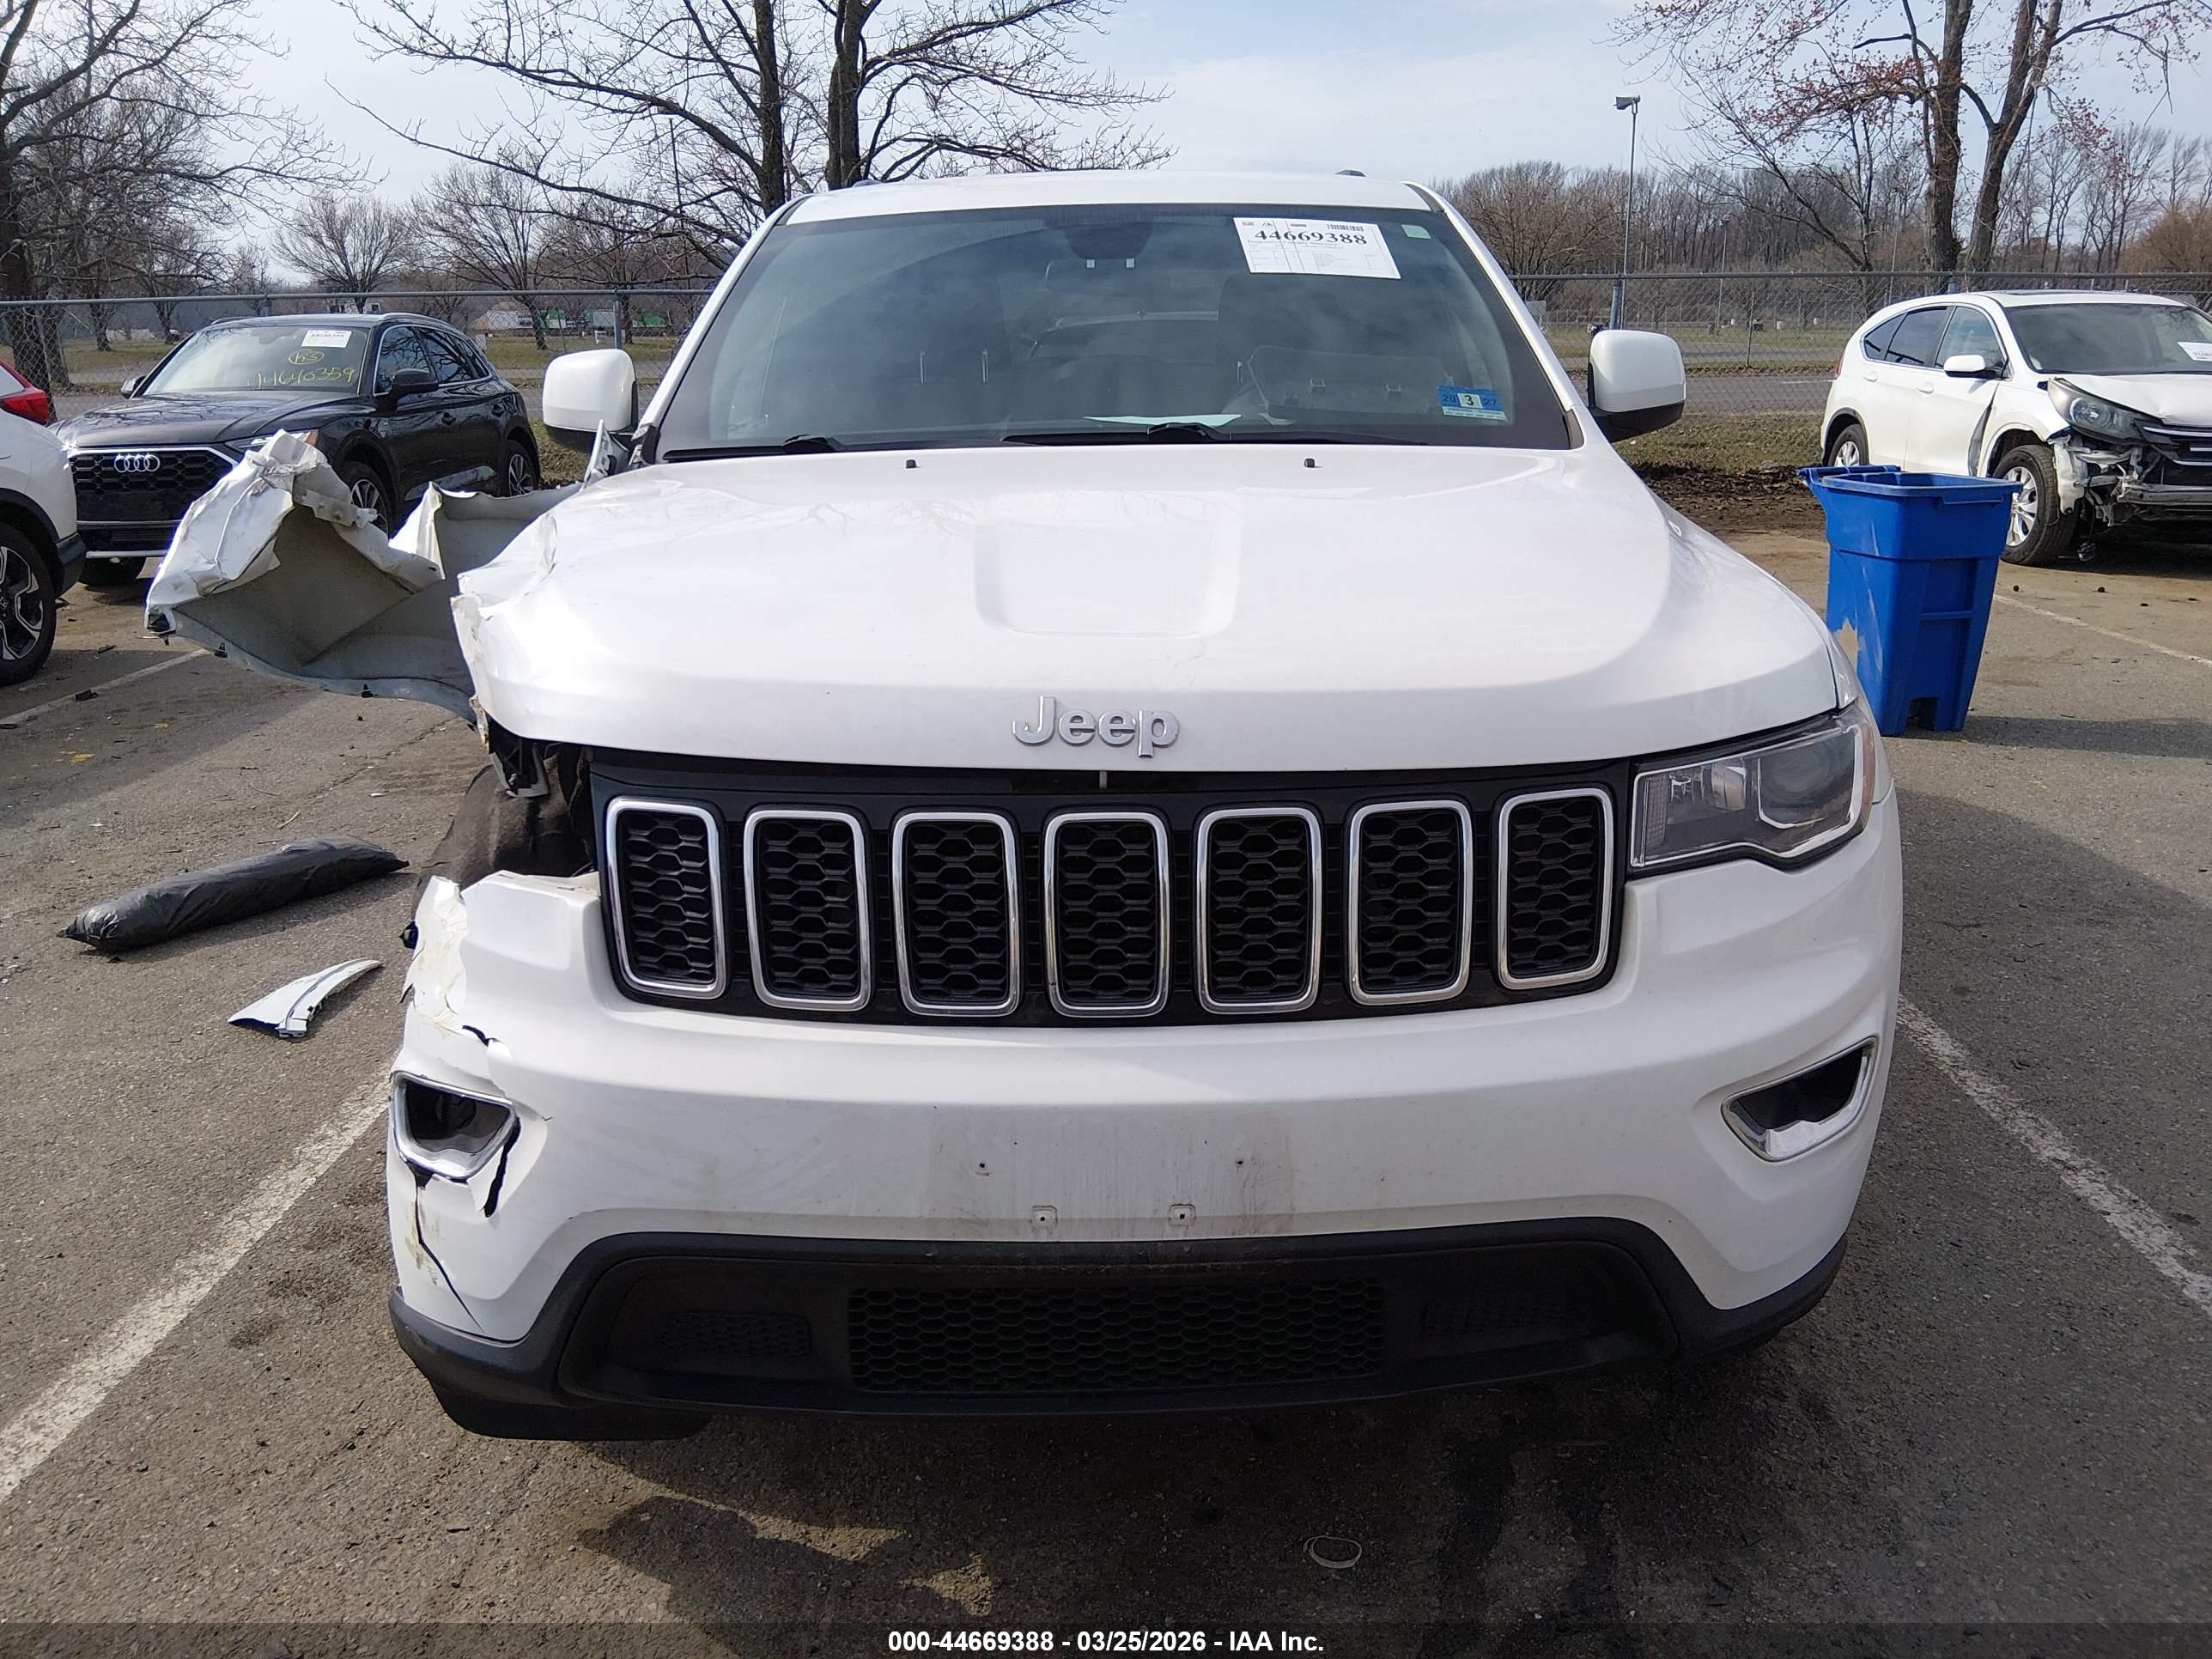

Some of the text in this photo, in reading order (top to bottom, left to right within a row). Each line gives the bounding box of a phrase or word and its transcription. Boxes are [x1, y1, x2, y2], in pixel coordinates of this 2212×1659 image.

[1254, 230, 1368, 245] 44669388
[1464, 395, 1474, 406] 3
[1012, 695, 1180, 758] Jeep
